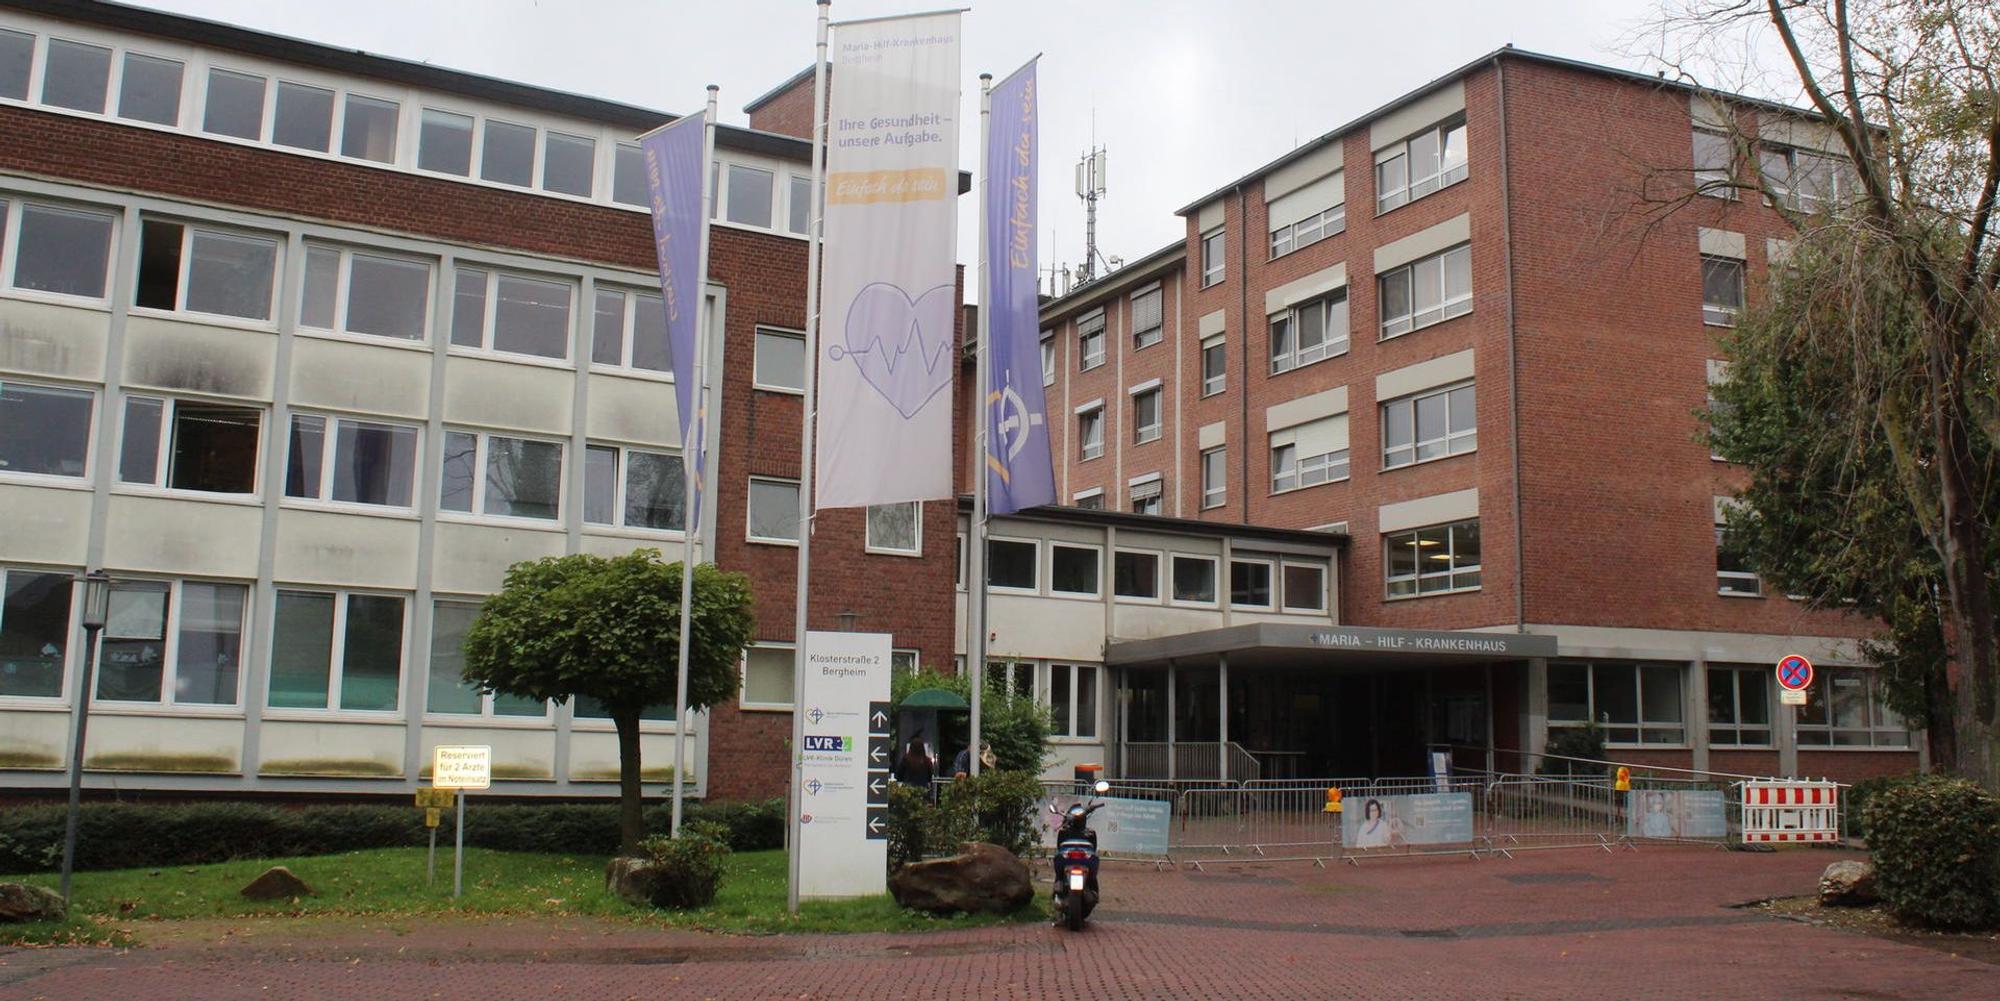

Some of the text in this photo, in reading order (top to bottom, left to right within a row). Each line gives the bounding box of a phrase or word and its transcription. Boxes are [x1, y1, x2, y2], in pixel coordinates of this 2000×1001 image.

[839, 118, 865, 131] Ihre
[870, 112, 941, 130] Gesundheit
[838, 131, 943, 148] unsere Aufgabe.
[1014, 131, 1031, 167] da
[1010, 175, 1033, 270] Einfach
[1319, 633, 1361, 646] MARIA
[1377, 635, 1405, 648] HILF
[1415, 638, 1507, 652] KRANKENHAUS
[810, 654, 881, 665] Klosterstraße 2
[822, 666, 867, 678] Bergheim
[806, 737, 834, 750] LVR
[440, 751, 486, 760] Reserviert
[454, 763, 460, 771] 2
